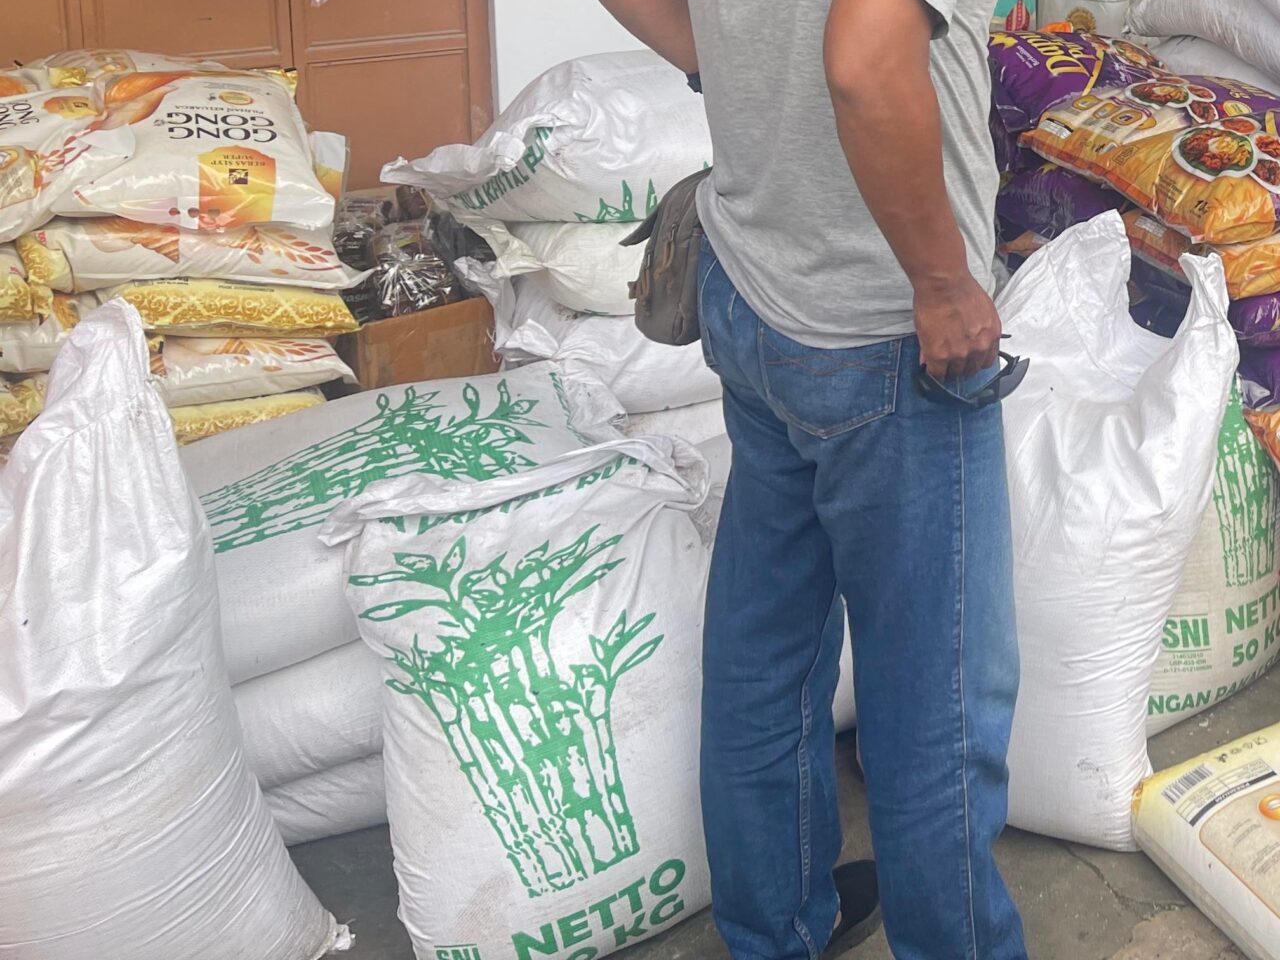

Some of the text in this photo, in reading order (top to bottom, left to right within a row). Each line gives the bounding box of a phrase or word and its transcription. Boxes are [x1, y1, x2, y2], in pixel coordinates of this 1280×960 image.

[166, 112, 275, 127] GONG
[168, 127, 278, 143] GONG
[1161, 618, 1211, 649] SNI
[1232, 639, 1259, 668] 50
[1148, 690, 1211, 715] NGAN
[511, 859, 686, 960] NETTO
[613, 894, 685, 947] KG
